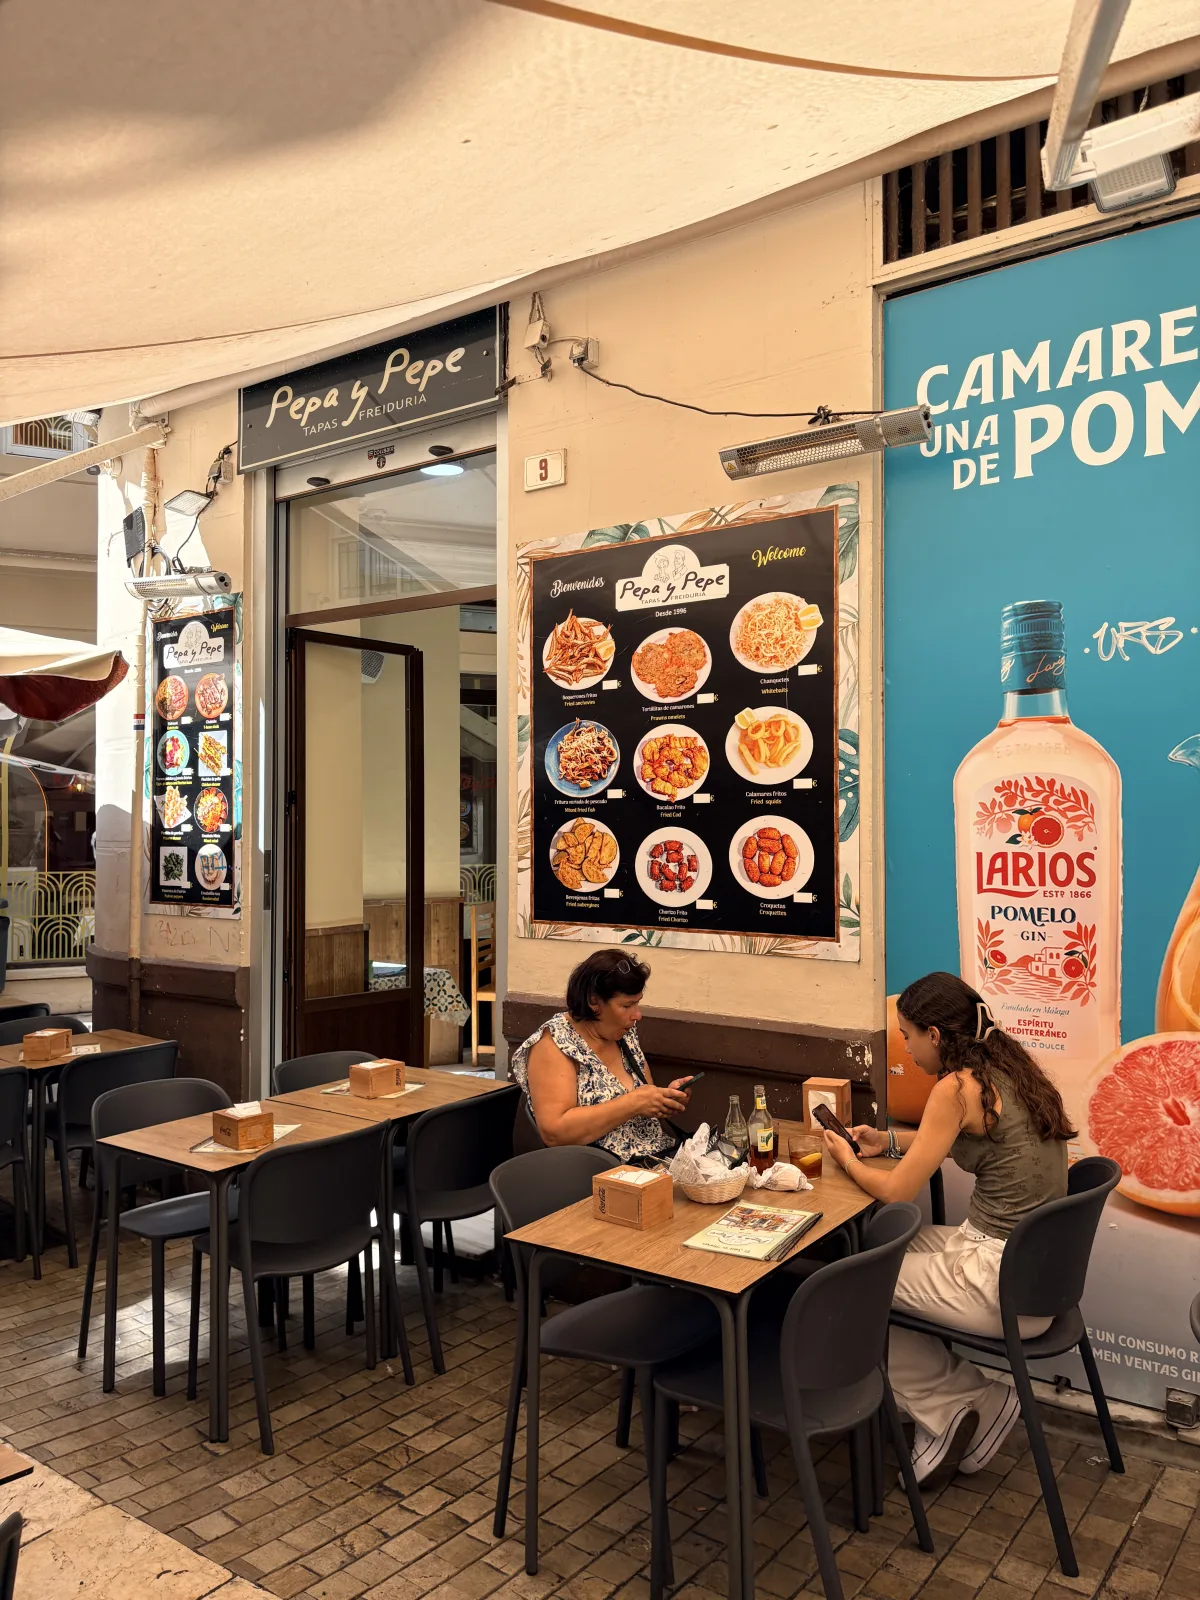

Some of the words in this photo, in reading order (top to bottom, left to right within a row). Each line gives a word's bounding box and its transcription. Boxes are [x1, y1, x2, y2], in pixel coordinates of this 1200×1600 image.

[916, 305, 1198, 415] CAMARE
[265, 385, 339, 428] Pepa
[341, 380, 369, 427] y
[377, 347, 466, 395] Pepe
[302, 418, 338, 438] TAPAS
[359, 393, 427, 421] FREIDURIA
[919, 413, 999, 458] UNA
[1012, 380, 1200, 479] POM
[539, 458, 548, 481] 9
[952, 452, 1000, 490] DE
[751, 545, 807, 568] Welcome
[550, 576, 606, 599] Bienvenidos
[619, 580, 660, 601] Pepa
[661, 582, 676, 603] y
[681, 571, 726, 592] Pepe
[641, 597, 661, 605] TAPAS
[655, 608, 672, 617] Desde
[673, 607, 687, 616] 1996
[166, 646, 188, 661] Pepa
[189, 649, 197, 664] y
[199, 641, 222, 657] Pepe
[760, 677, 790, 685] Chanquetes
[670, 703, 695, 711] camarones
[589, 798, 608, 806] pescado
[674, 803, 686, 811] Frito
[765, 798, 783, 806] squids
[976, 850, 1097, 898] LARIOS
[565, 894, 588, 902] Berenjenas
[1069, 890, 1092, 899] 1866
[759, 902, 786, 910] Croquetas
[759, 909, 787, 917] Croquettes
[990, 905, 1076, 927] POMELO
[1021, 930, 1047, 942] GIN
[1001, 1001, 1032, 1012] Fundada
[1042, 1006, 1070, 1017] Málaga
[1017, 1018, 1054, 1029] ESPÍRITU
[1005, 1026, 1067, 1039] MEDITERRÁNEO
[1039, 1042, 1065, 1051] DULCE
[1096, 1329, 1115, 1344] UN
[1118, 1334, 1187, 1361] CONSUMO
[1123, 1354, 1178, 1378] VENTAS
